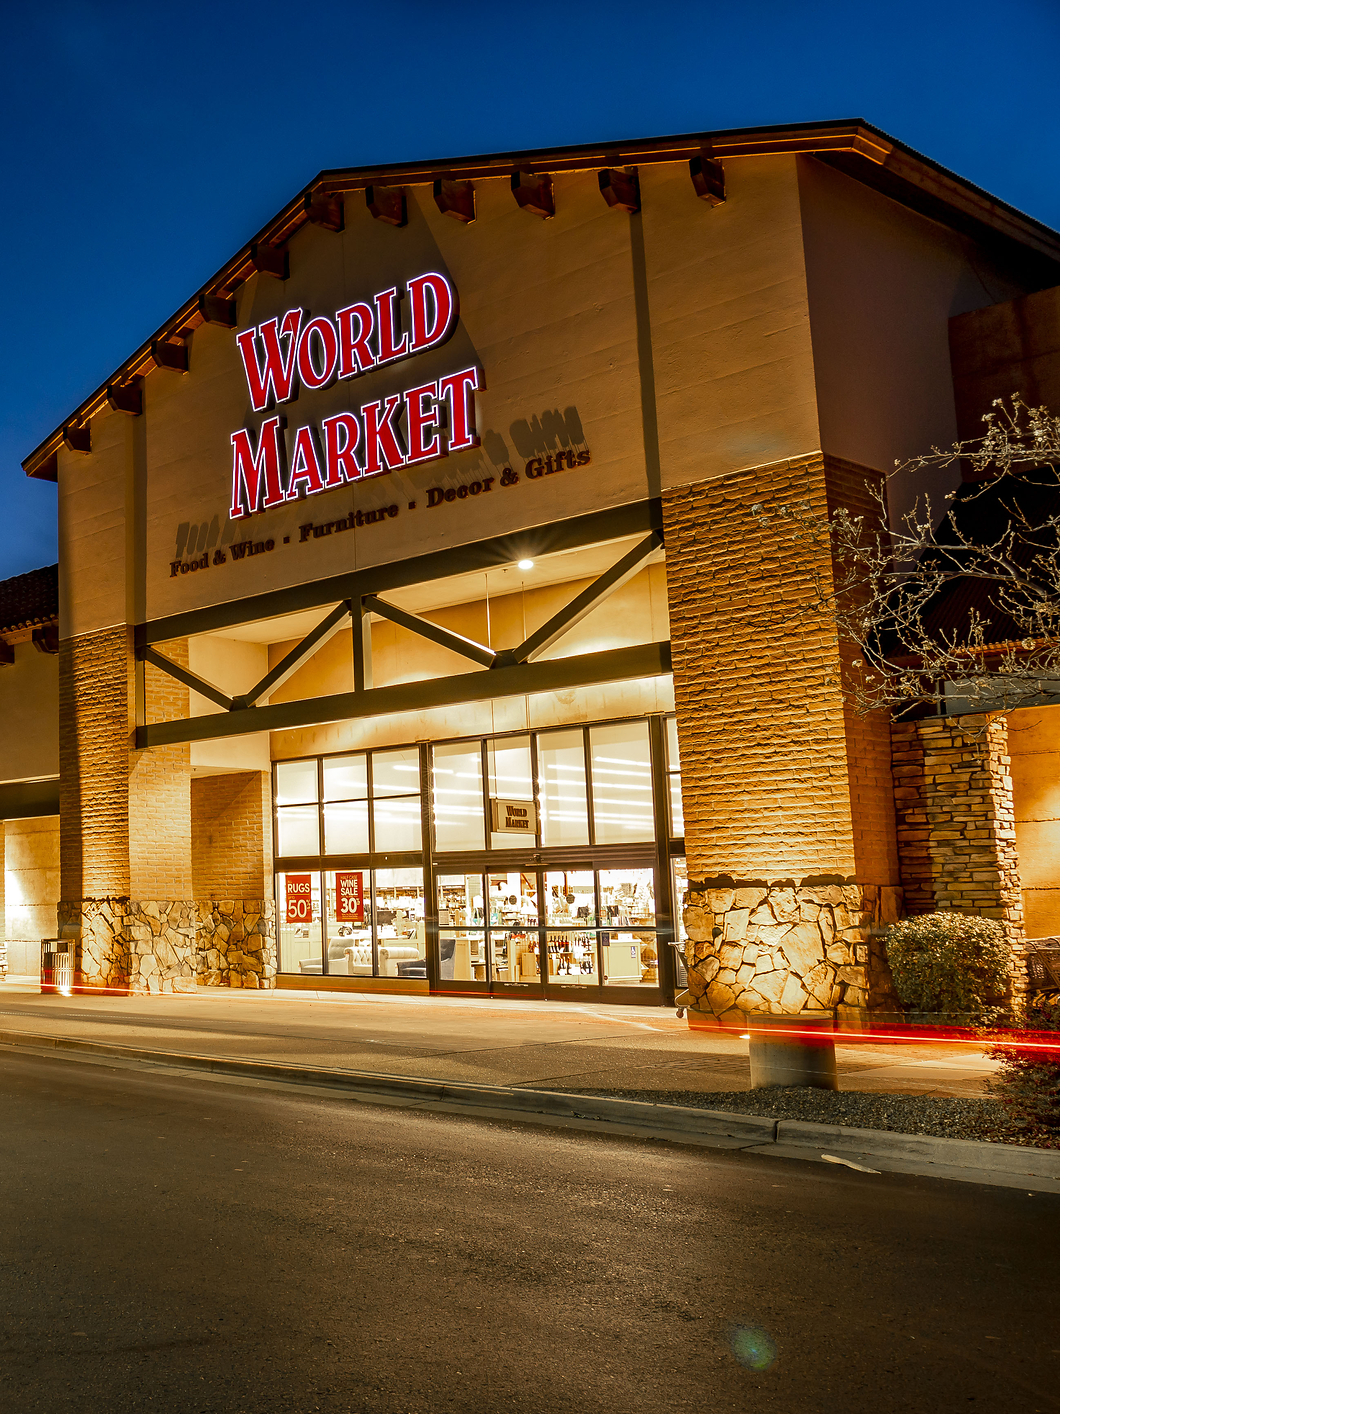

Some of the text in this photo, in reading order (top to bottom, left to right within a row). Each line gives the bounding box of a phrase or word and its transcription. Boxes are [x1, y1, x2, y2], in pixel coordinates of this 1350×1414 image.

[236, 272, 453, 412] WORLD
[230, 366, 480, 520] MARKET
[169, 450, 592, 577] Food & Wine Furniture Decor & Gifts
[287, 883, 310, 893] RUGS
[340, 879, 358, 887] WINE
[340, 887, 358, 896] SALE
